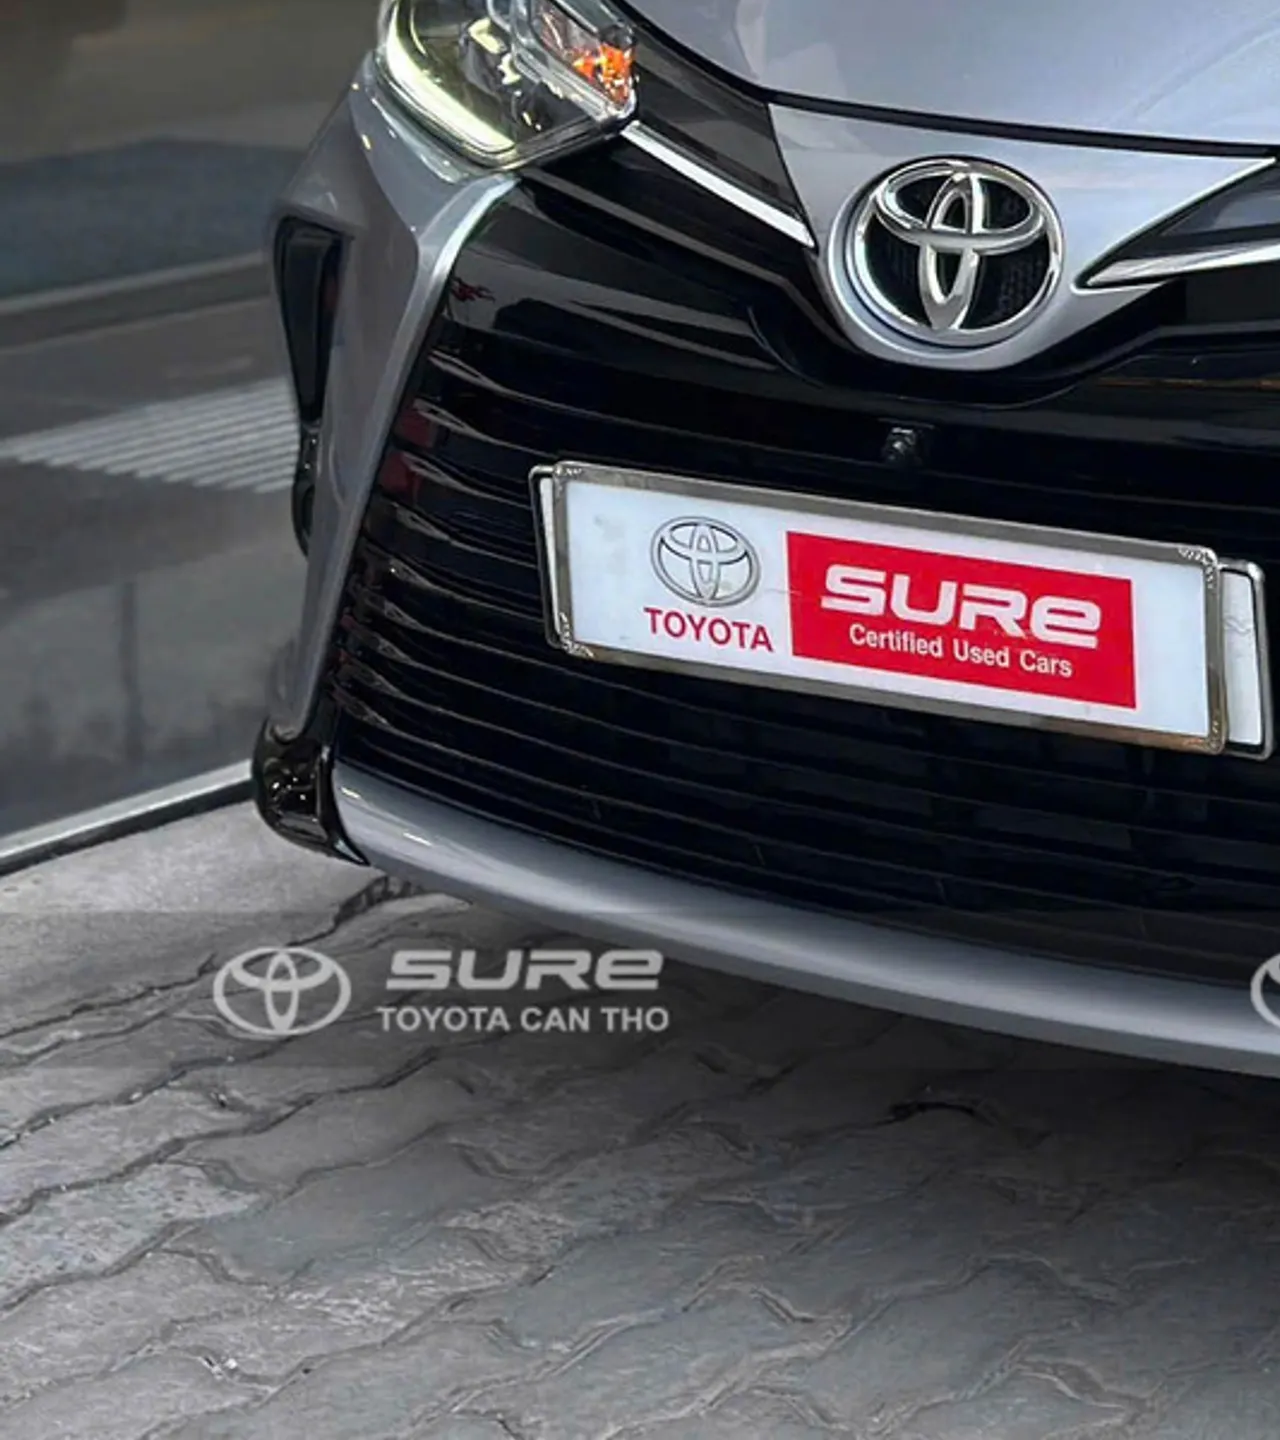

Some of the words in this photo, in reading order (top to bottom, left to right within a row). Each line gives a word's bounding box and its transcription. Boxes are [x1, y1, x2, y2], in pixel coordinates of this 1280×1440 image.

[644, 605, 775, 653] TOYOTA
[849, 622, 944, 659] Certified
[952, 636, 1010, 670] Used
[1018, 648, 1073, 679] Cars
